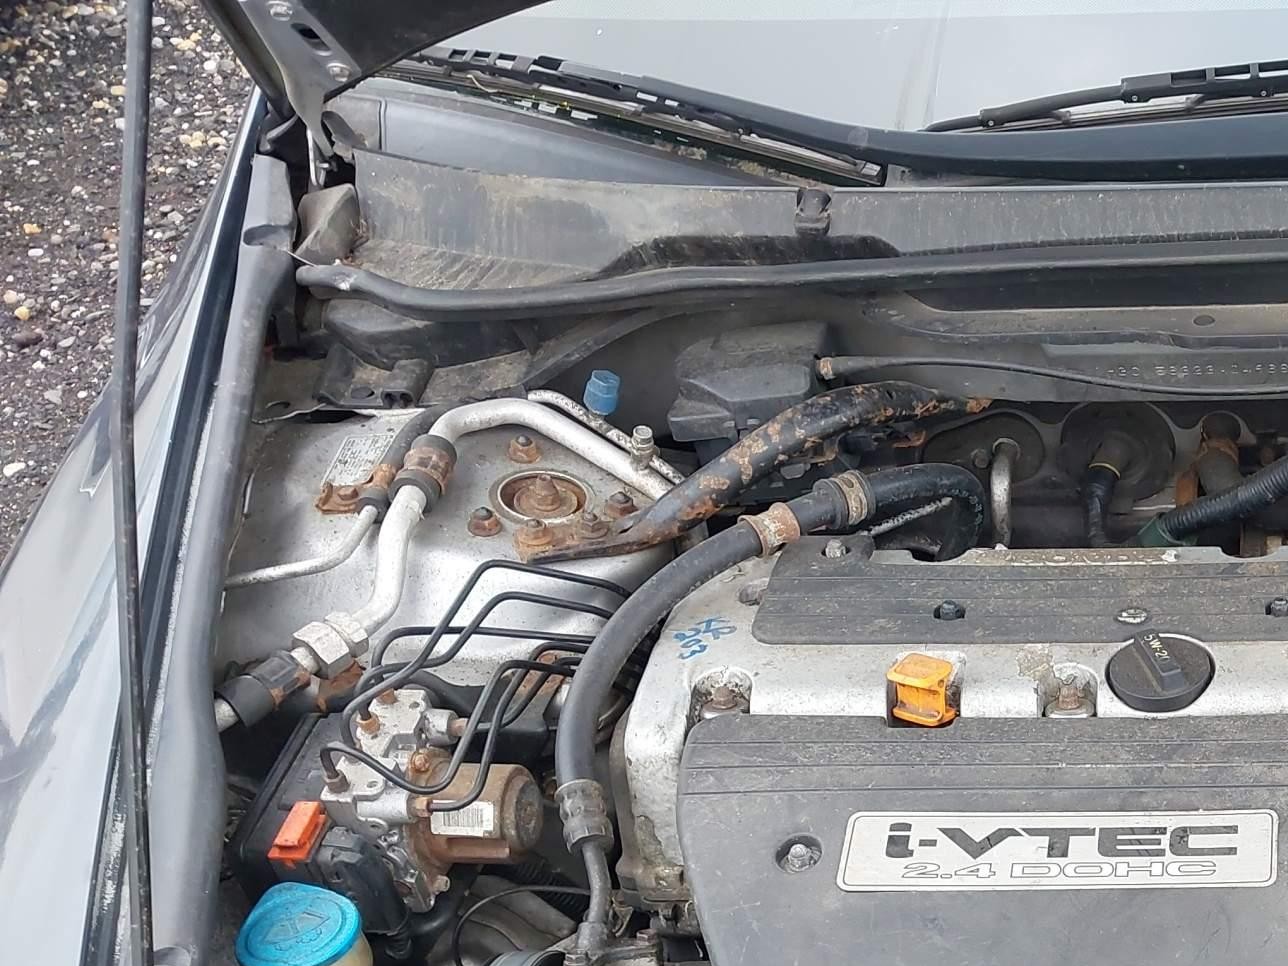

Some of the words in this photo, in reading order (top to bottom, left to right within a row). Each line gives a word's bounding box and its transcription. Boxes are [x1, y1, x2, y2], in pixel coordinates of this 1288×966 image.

[886, 822, 1239, 860] i-VTEC
[901, 862, 997, 879] 2.4
[1010, 860, 1217, 879] DOHC
